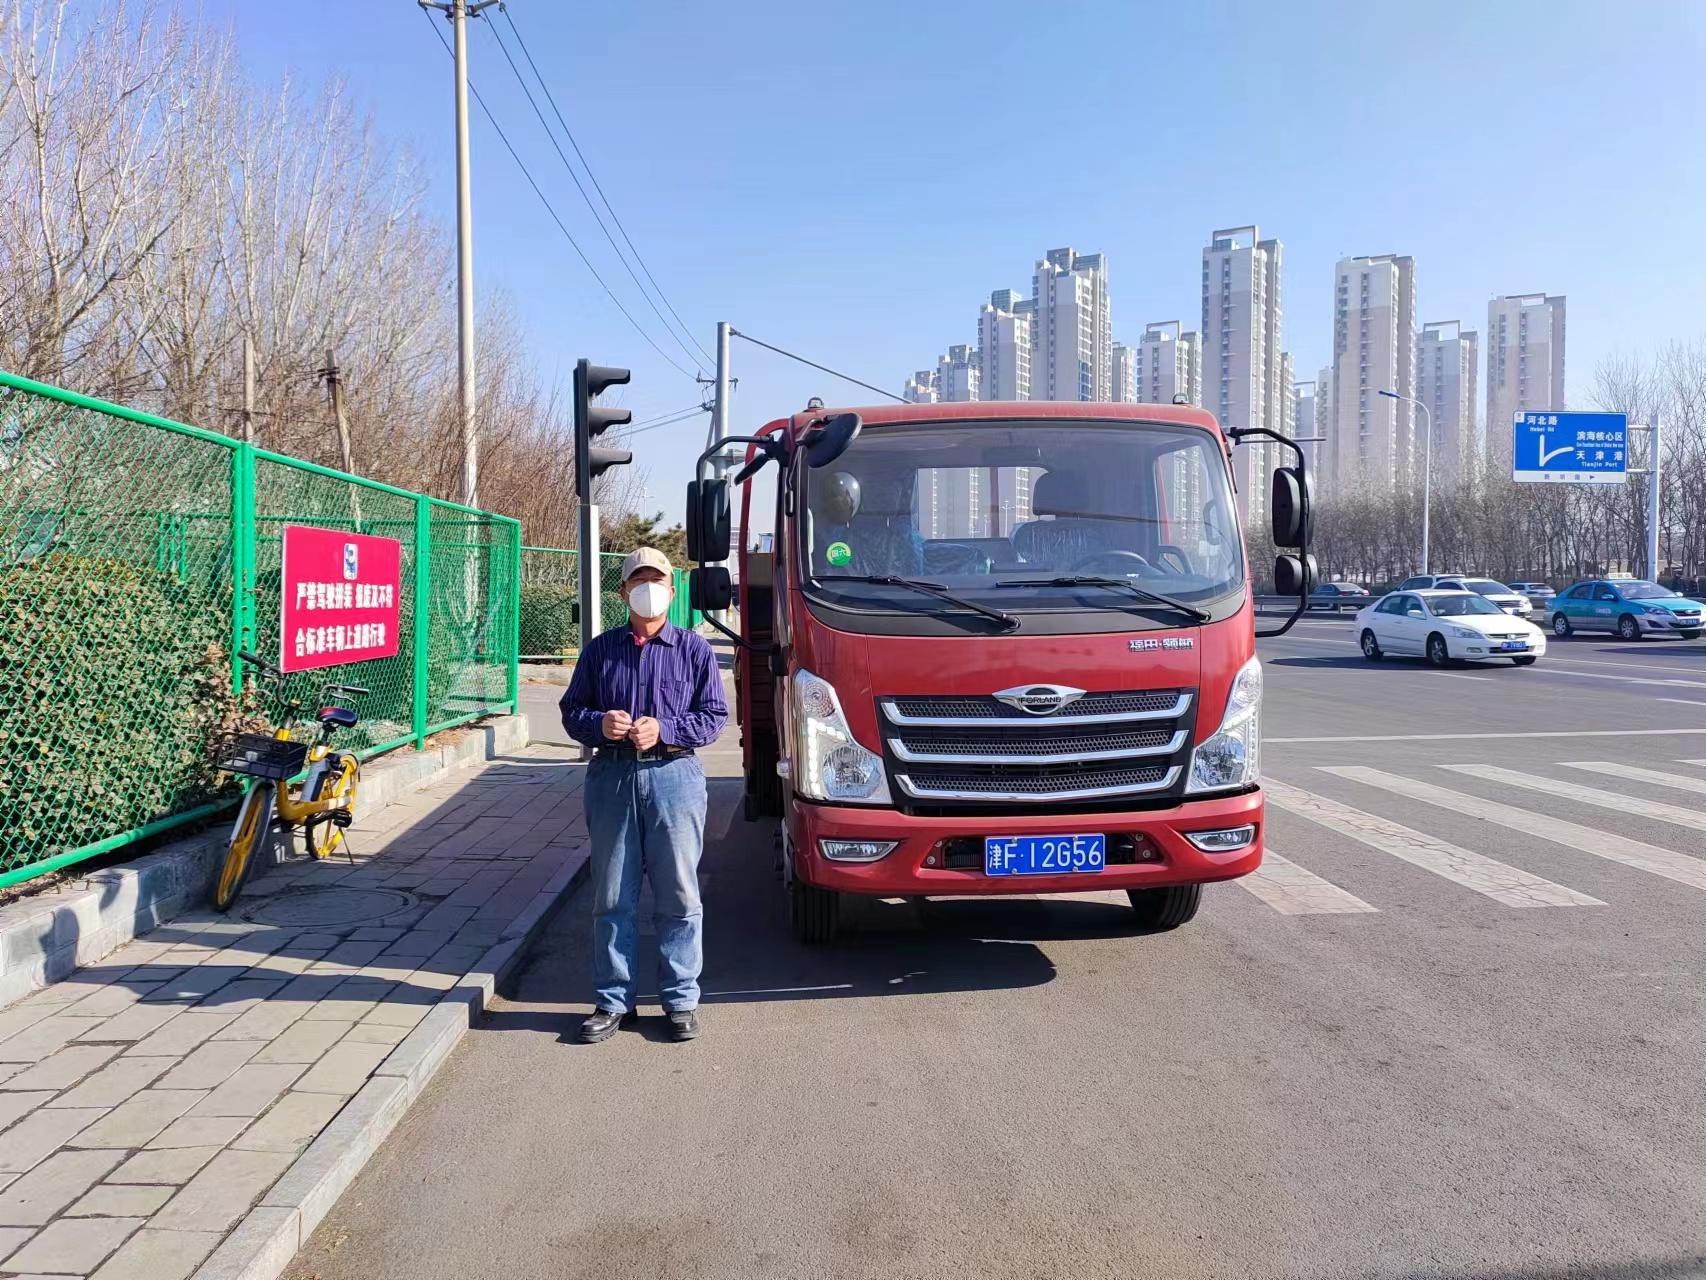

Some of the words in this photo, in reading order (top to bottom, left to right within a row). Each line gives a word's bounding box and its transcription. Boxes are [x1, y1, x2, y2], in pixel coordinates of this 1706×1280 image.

[1527, 415, 1558, 425] 河北路
[1576, 431, 1623, 441] 滨海核心区
[1576, 450, 1623, 460] 天津港
[295, 622, 386, 657] 合标准车辆上道路行驶
[1020, 696, 1062, 704] FORLAND
